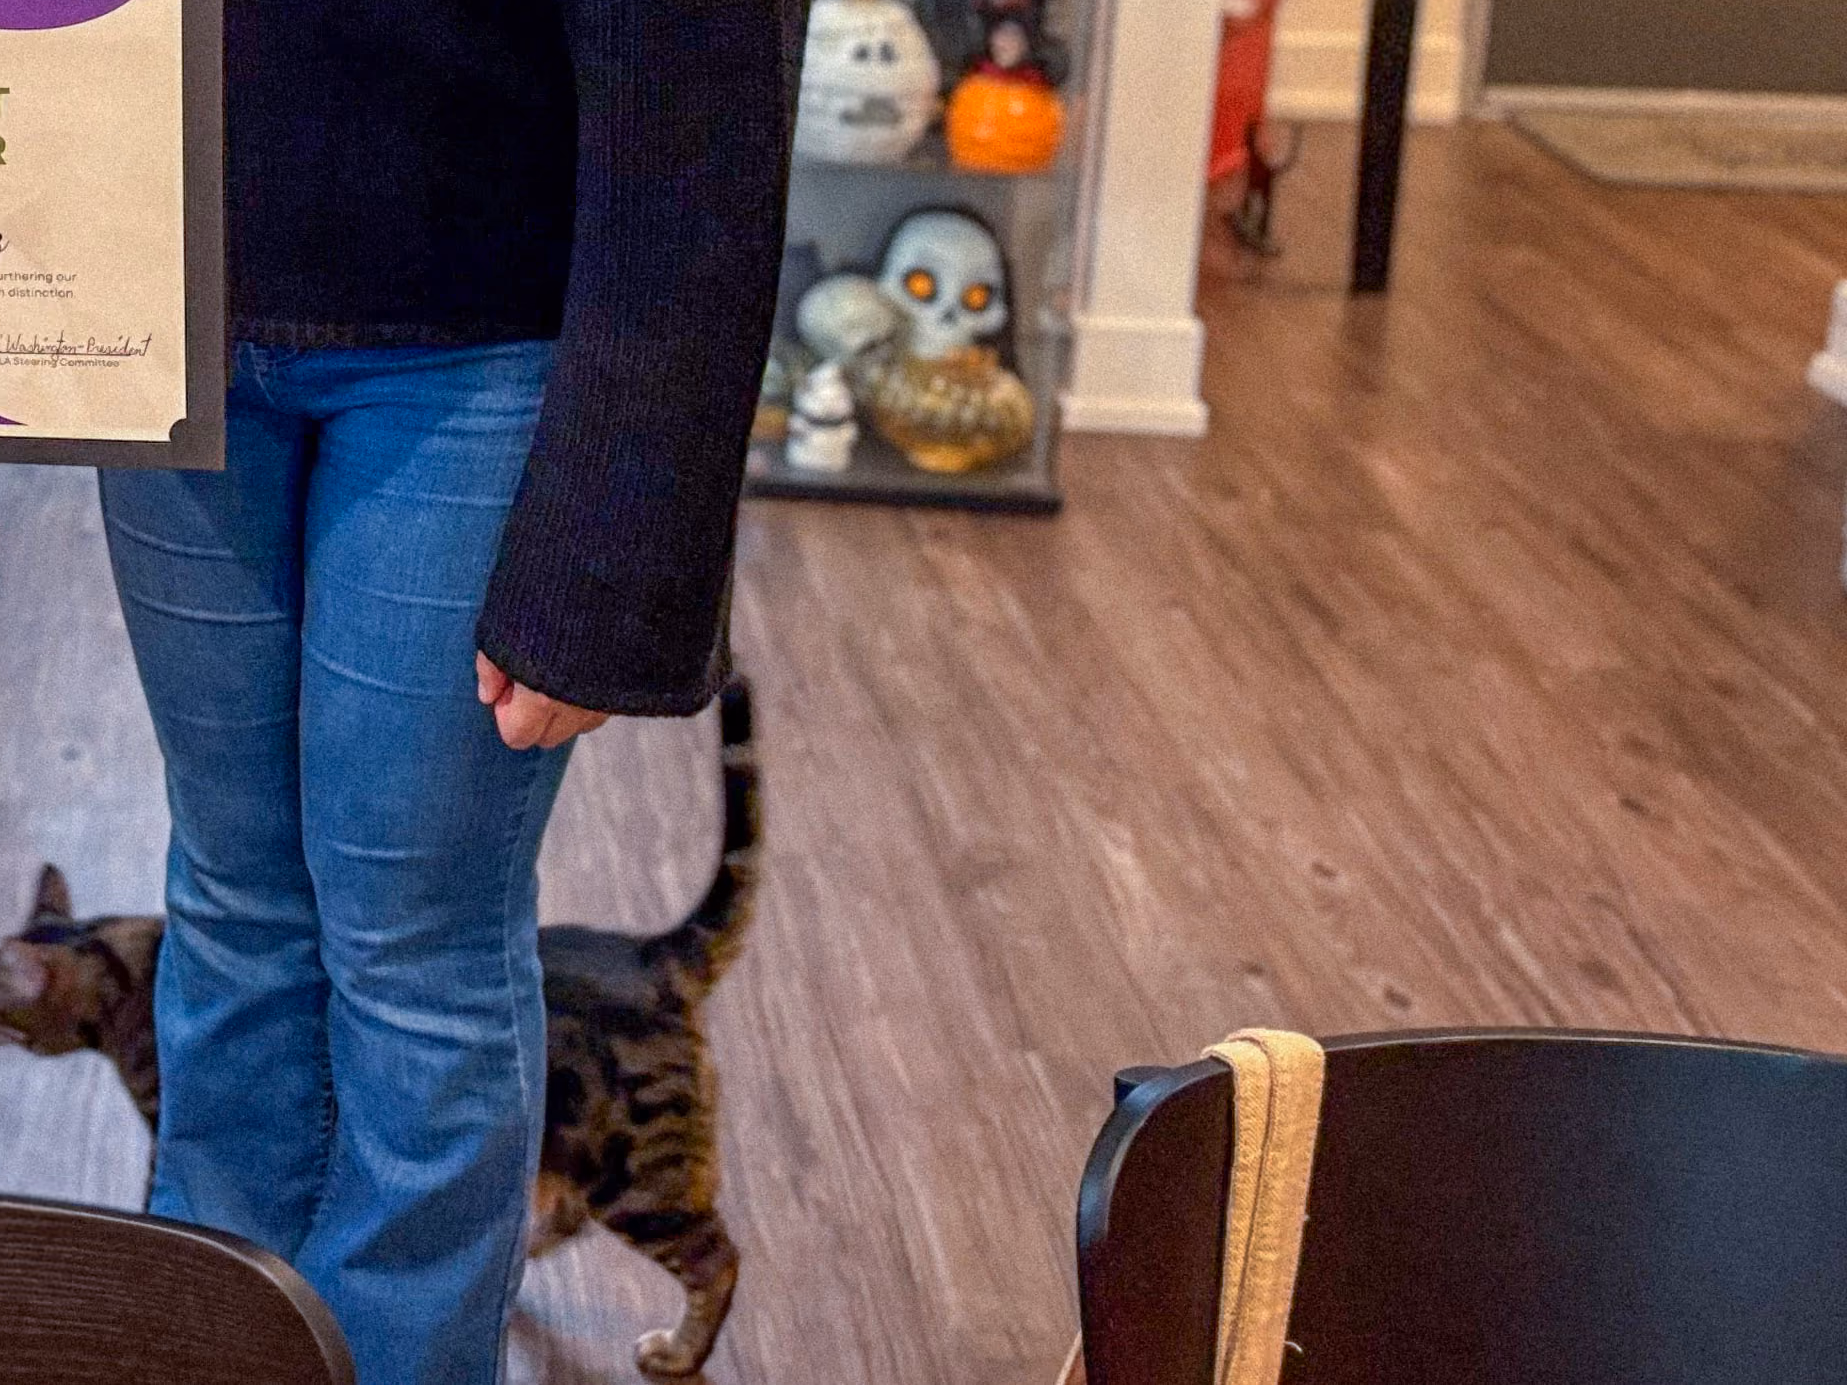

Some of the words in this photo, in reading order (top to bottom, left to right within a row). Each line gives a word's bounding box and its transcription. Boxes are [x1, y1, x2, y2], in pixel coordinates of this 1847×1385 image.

[56, 273, 77, 282] our
[13, 357, 57, 368] Steering
[60, 358, 120, 368] Committee
